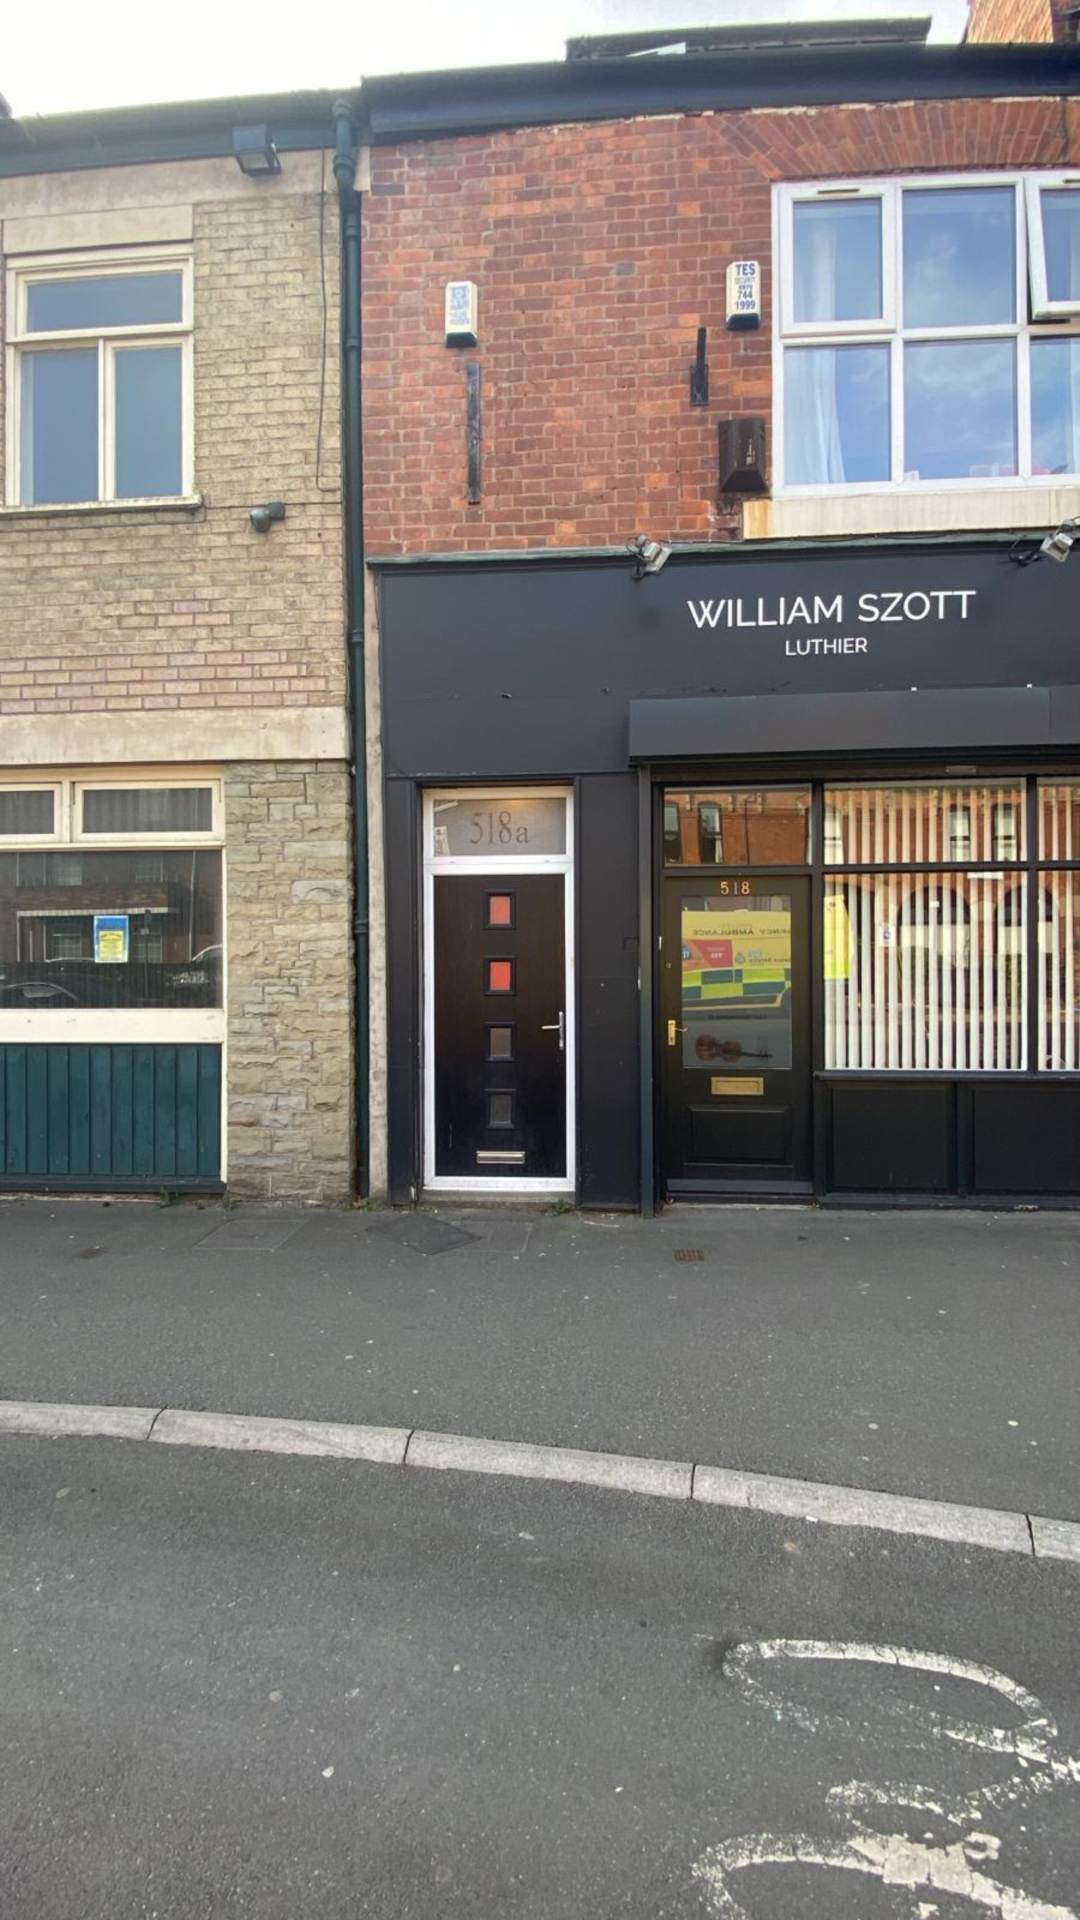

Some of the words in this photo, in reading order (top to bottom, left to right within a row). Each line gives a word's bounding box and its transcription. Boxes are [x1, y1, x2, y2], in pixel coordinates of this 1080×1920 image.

[735, 263, 756, 276] TES
[737, 290, 753, 299] 744
[735, 300, 756, 310] 1999
[687, 594, 843, 629] WILLIAM
[858, 590, 977, 623] SZOTT
[785, 637, 868, 656] LUTHIER
[470, 811, 530, 845] 518a
[720, 881, 751, 895] 518
